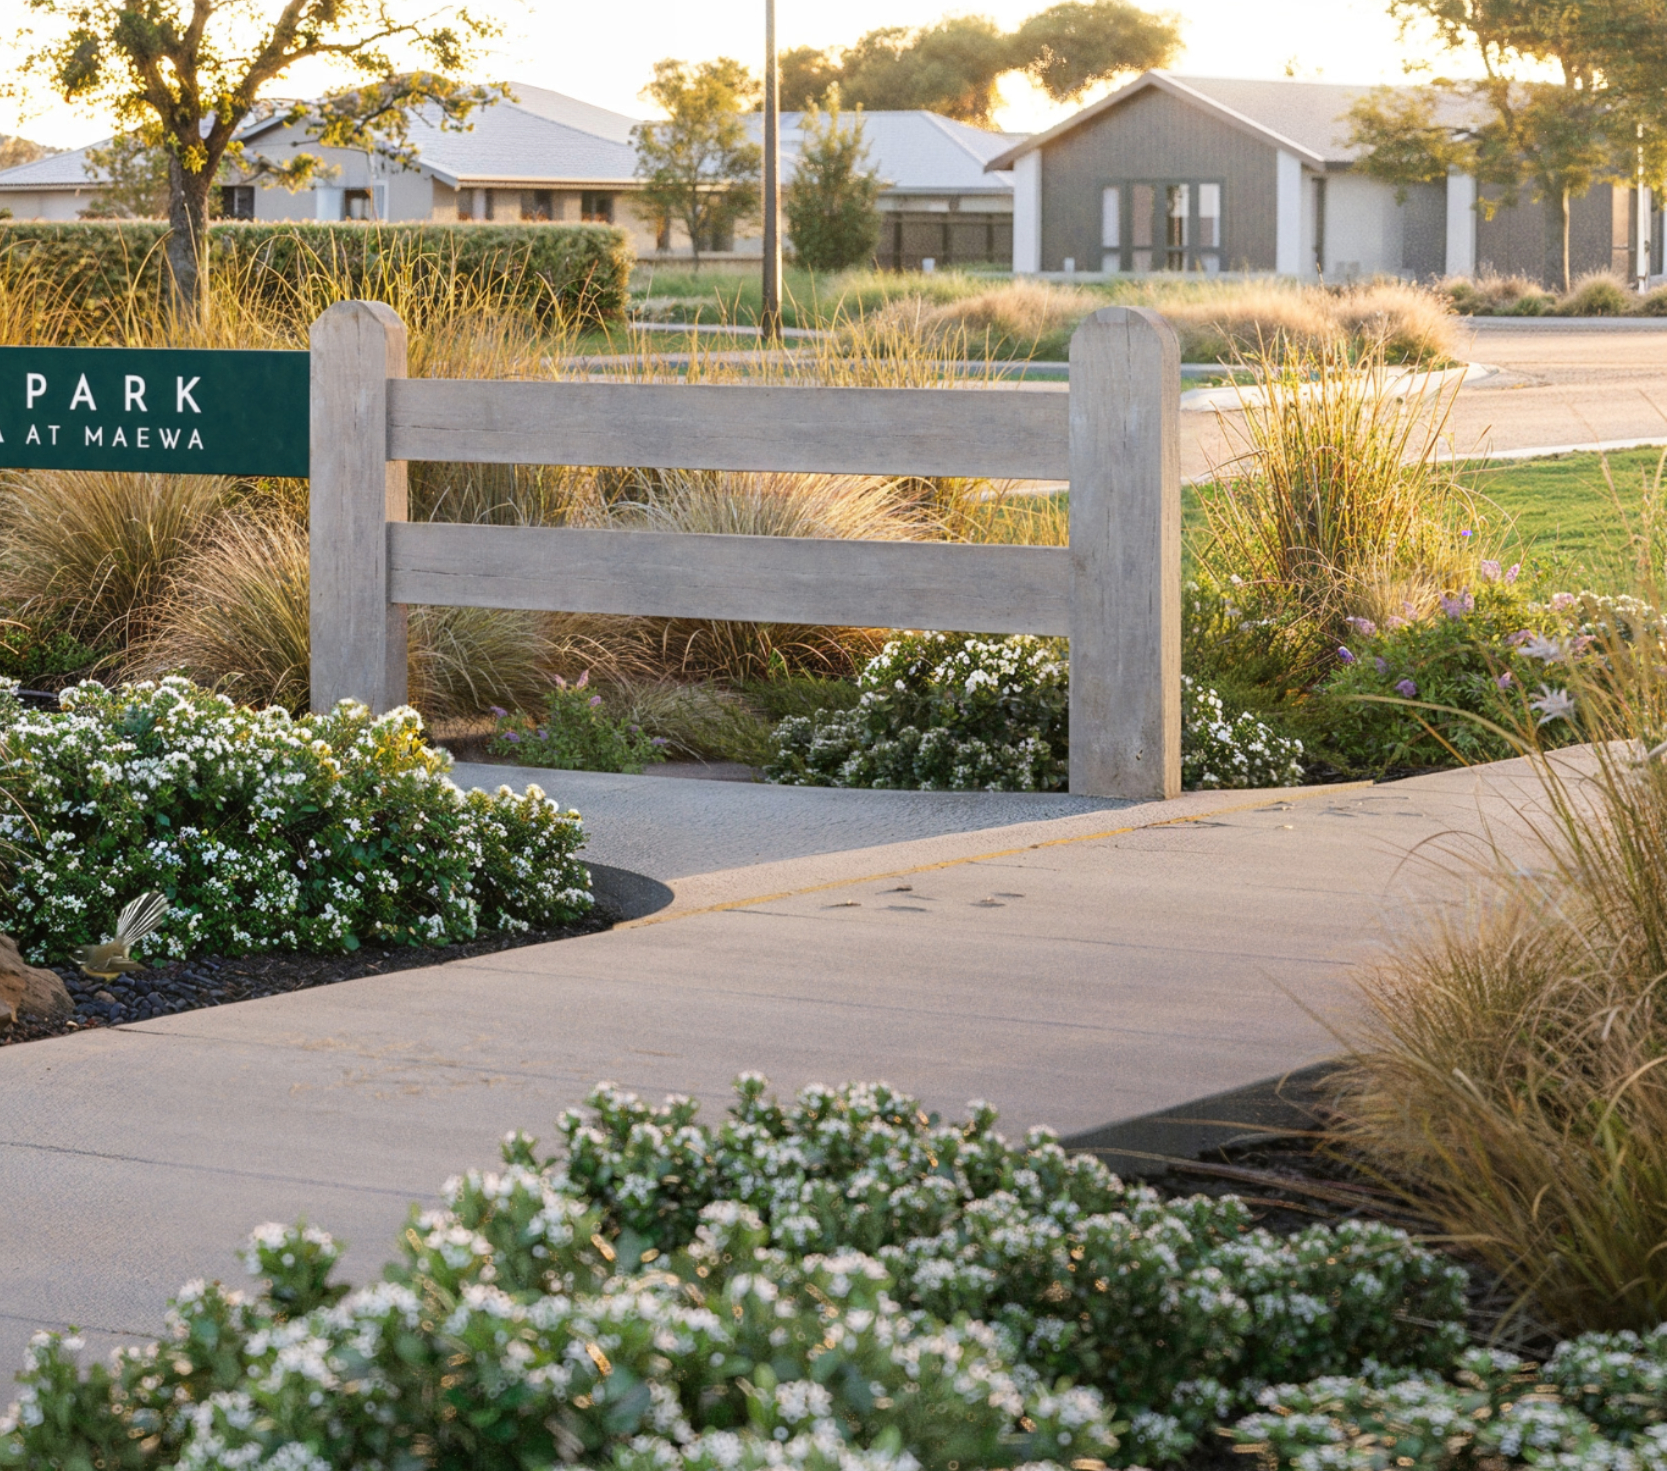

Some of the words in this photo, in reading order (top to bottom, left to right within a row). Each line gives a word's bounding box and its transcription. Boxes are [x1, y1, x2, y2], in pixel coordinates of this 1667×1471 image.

[26, 372, 202, 414] PARK
[26, 424, 60, 445] AT
[85, 426, 205, 450] MAEWA
